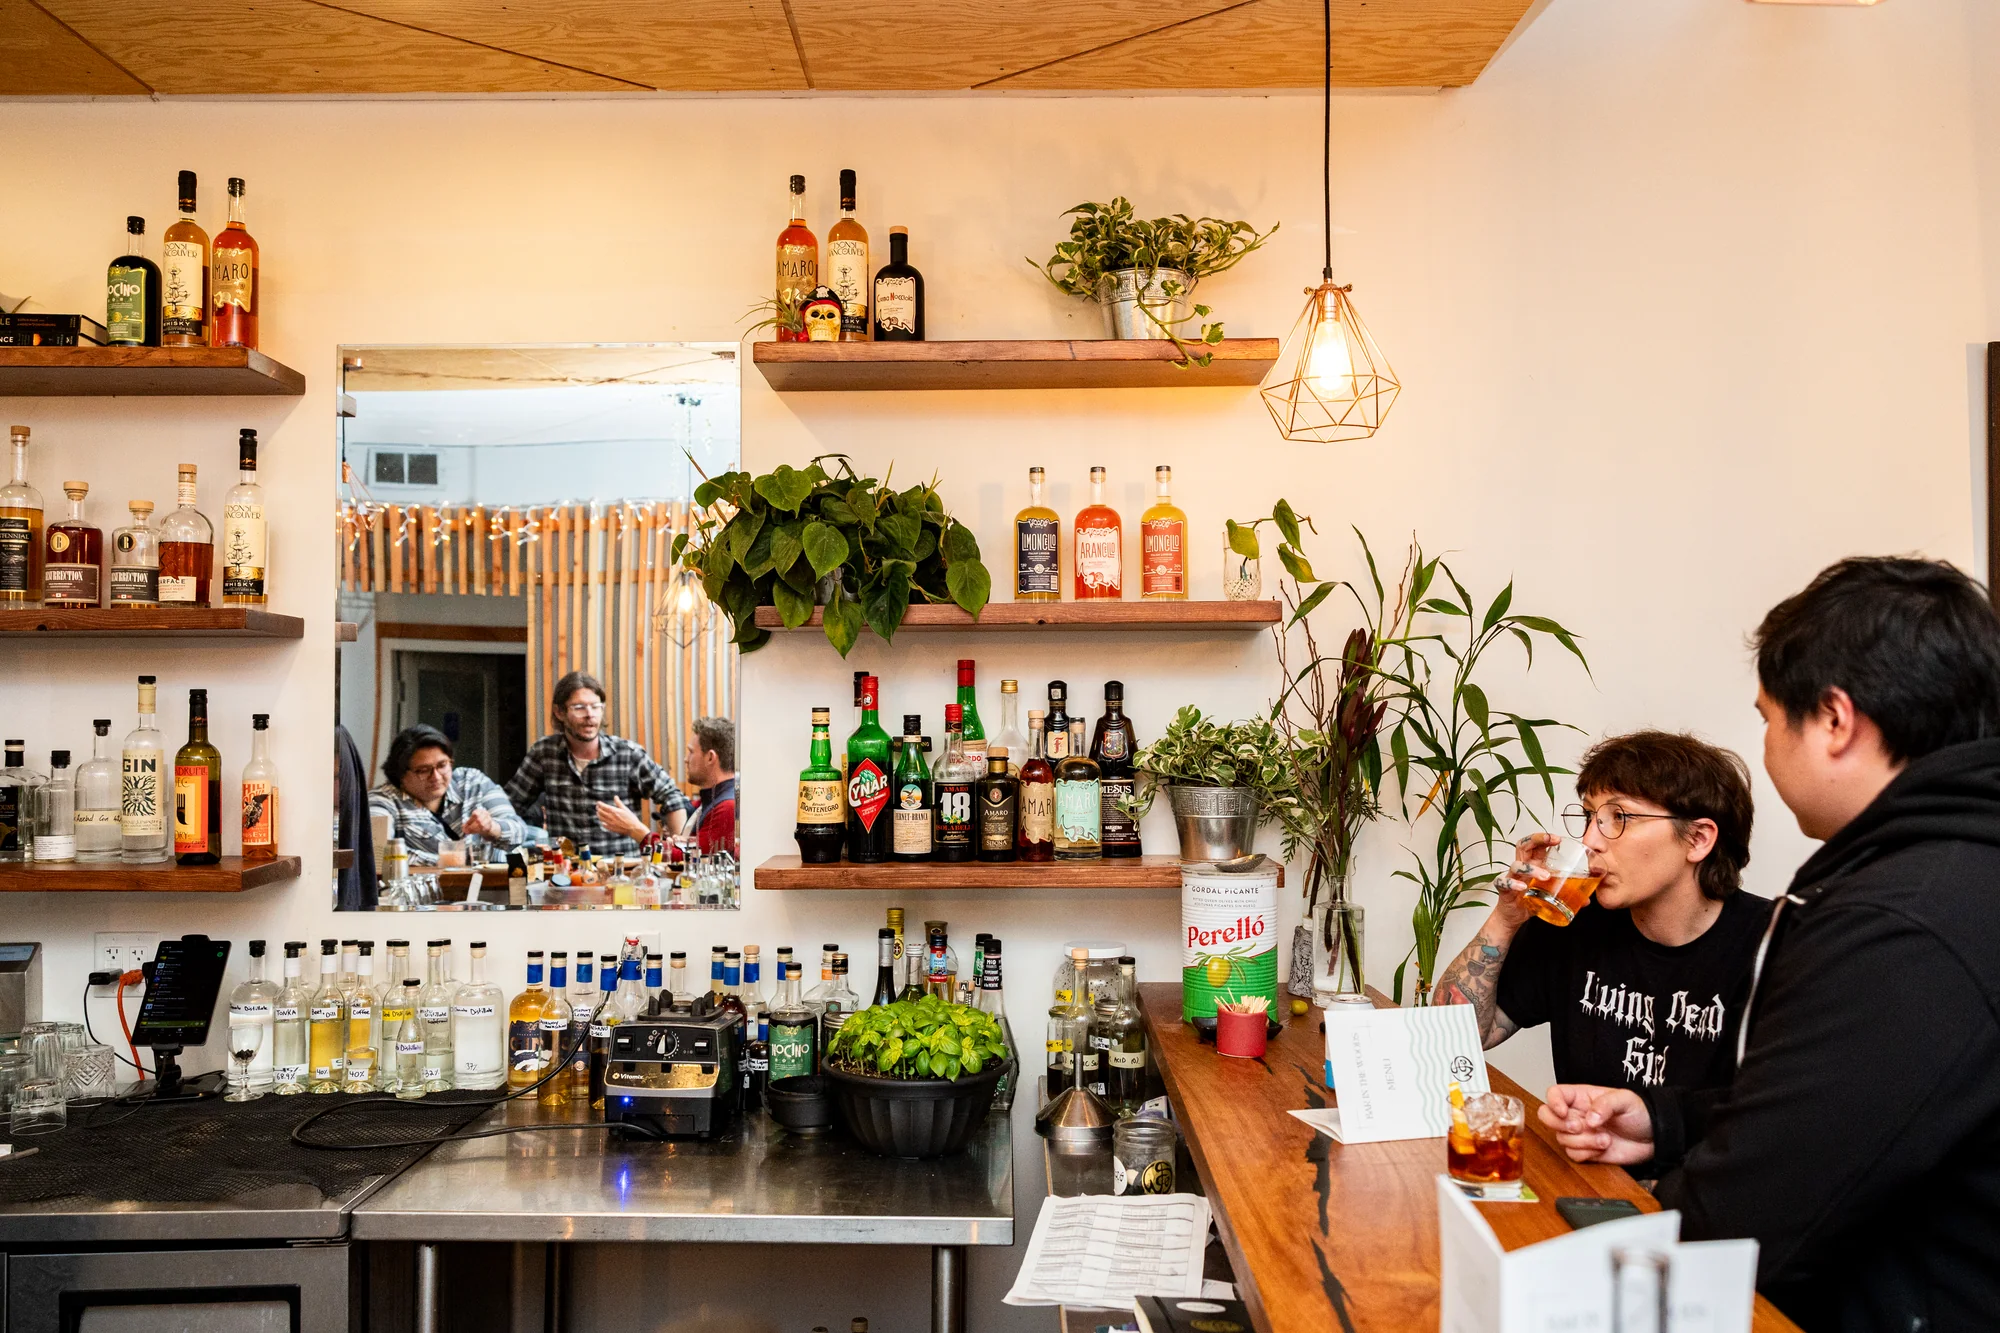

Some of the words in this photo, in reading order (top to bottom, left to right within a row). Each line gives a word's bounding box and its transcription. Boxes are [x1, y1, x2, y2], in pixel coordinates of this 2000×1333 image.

[213, 263, 249, 281] MARO
[776, 260, 814, 278] AMARO
[107, 282, 141, 297] OCINO
[0, 532, 30, 540] TENNIAL
[1021, 533, 1056, 551] LIMONCELLO
[1144, 535, 1180, 553] LIMONCELLO
[122, 758, 156, 773] GIN
[848, 774, 888, 808] CYNAR
[940, 792, 970, 823] 18
[1021, 795, 1053, 816] AMAR
[1191, 885, 1222, 895] GORDAL
[1224, 887, 1259, 895] PICANTE
[1187, 914, 1265, 948] Perelló
[1579, 970, 1655, 1042] Living
[1665, 990, 1726, 1042] Dead
[771, 1042, 810, 1058] NOCINO
[1351, 1032, 1364, 1069] WOODS
[1113, 1056, 1127, 1064] ACID
[1622, 1036, 1669, 1088] Girl
[316, 1067, 329, 1075] 40%
[1381, 1058, 1397, 1091] MENU
